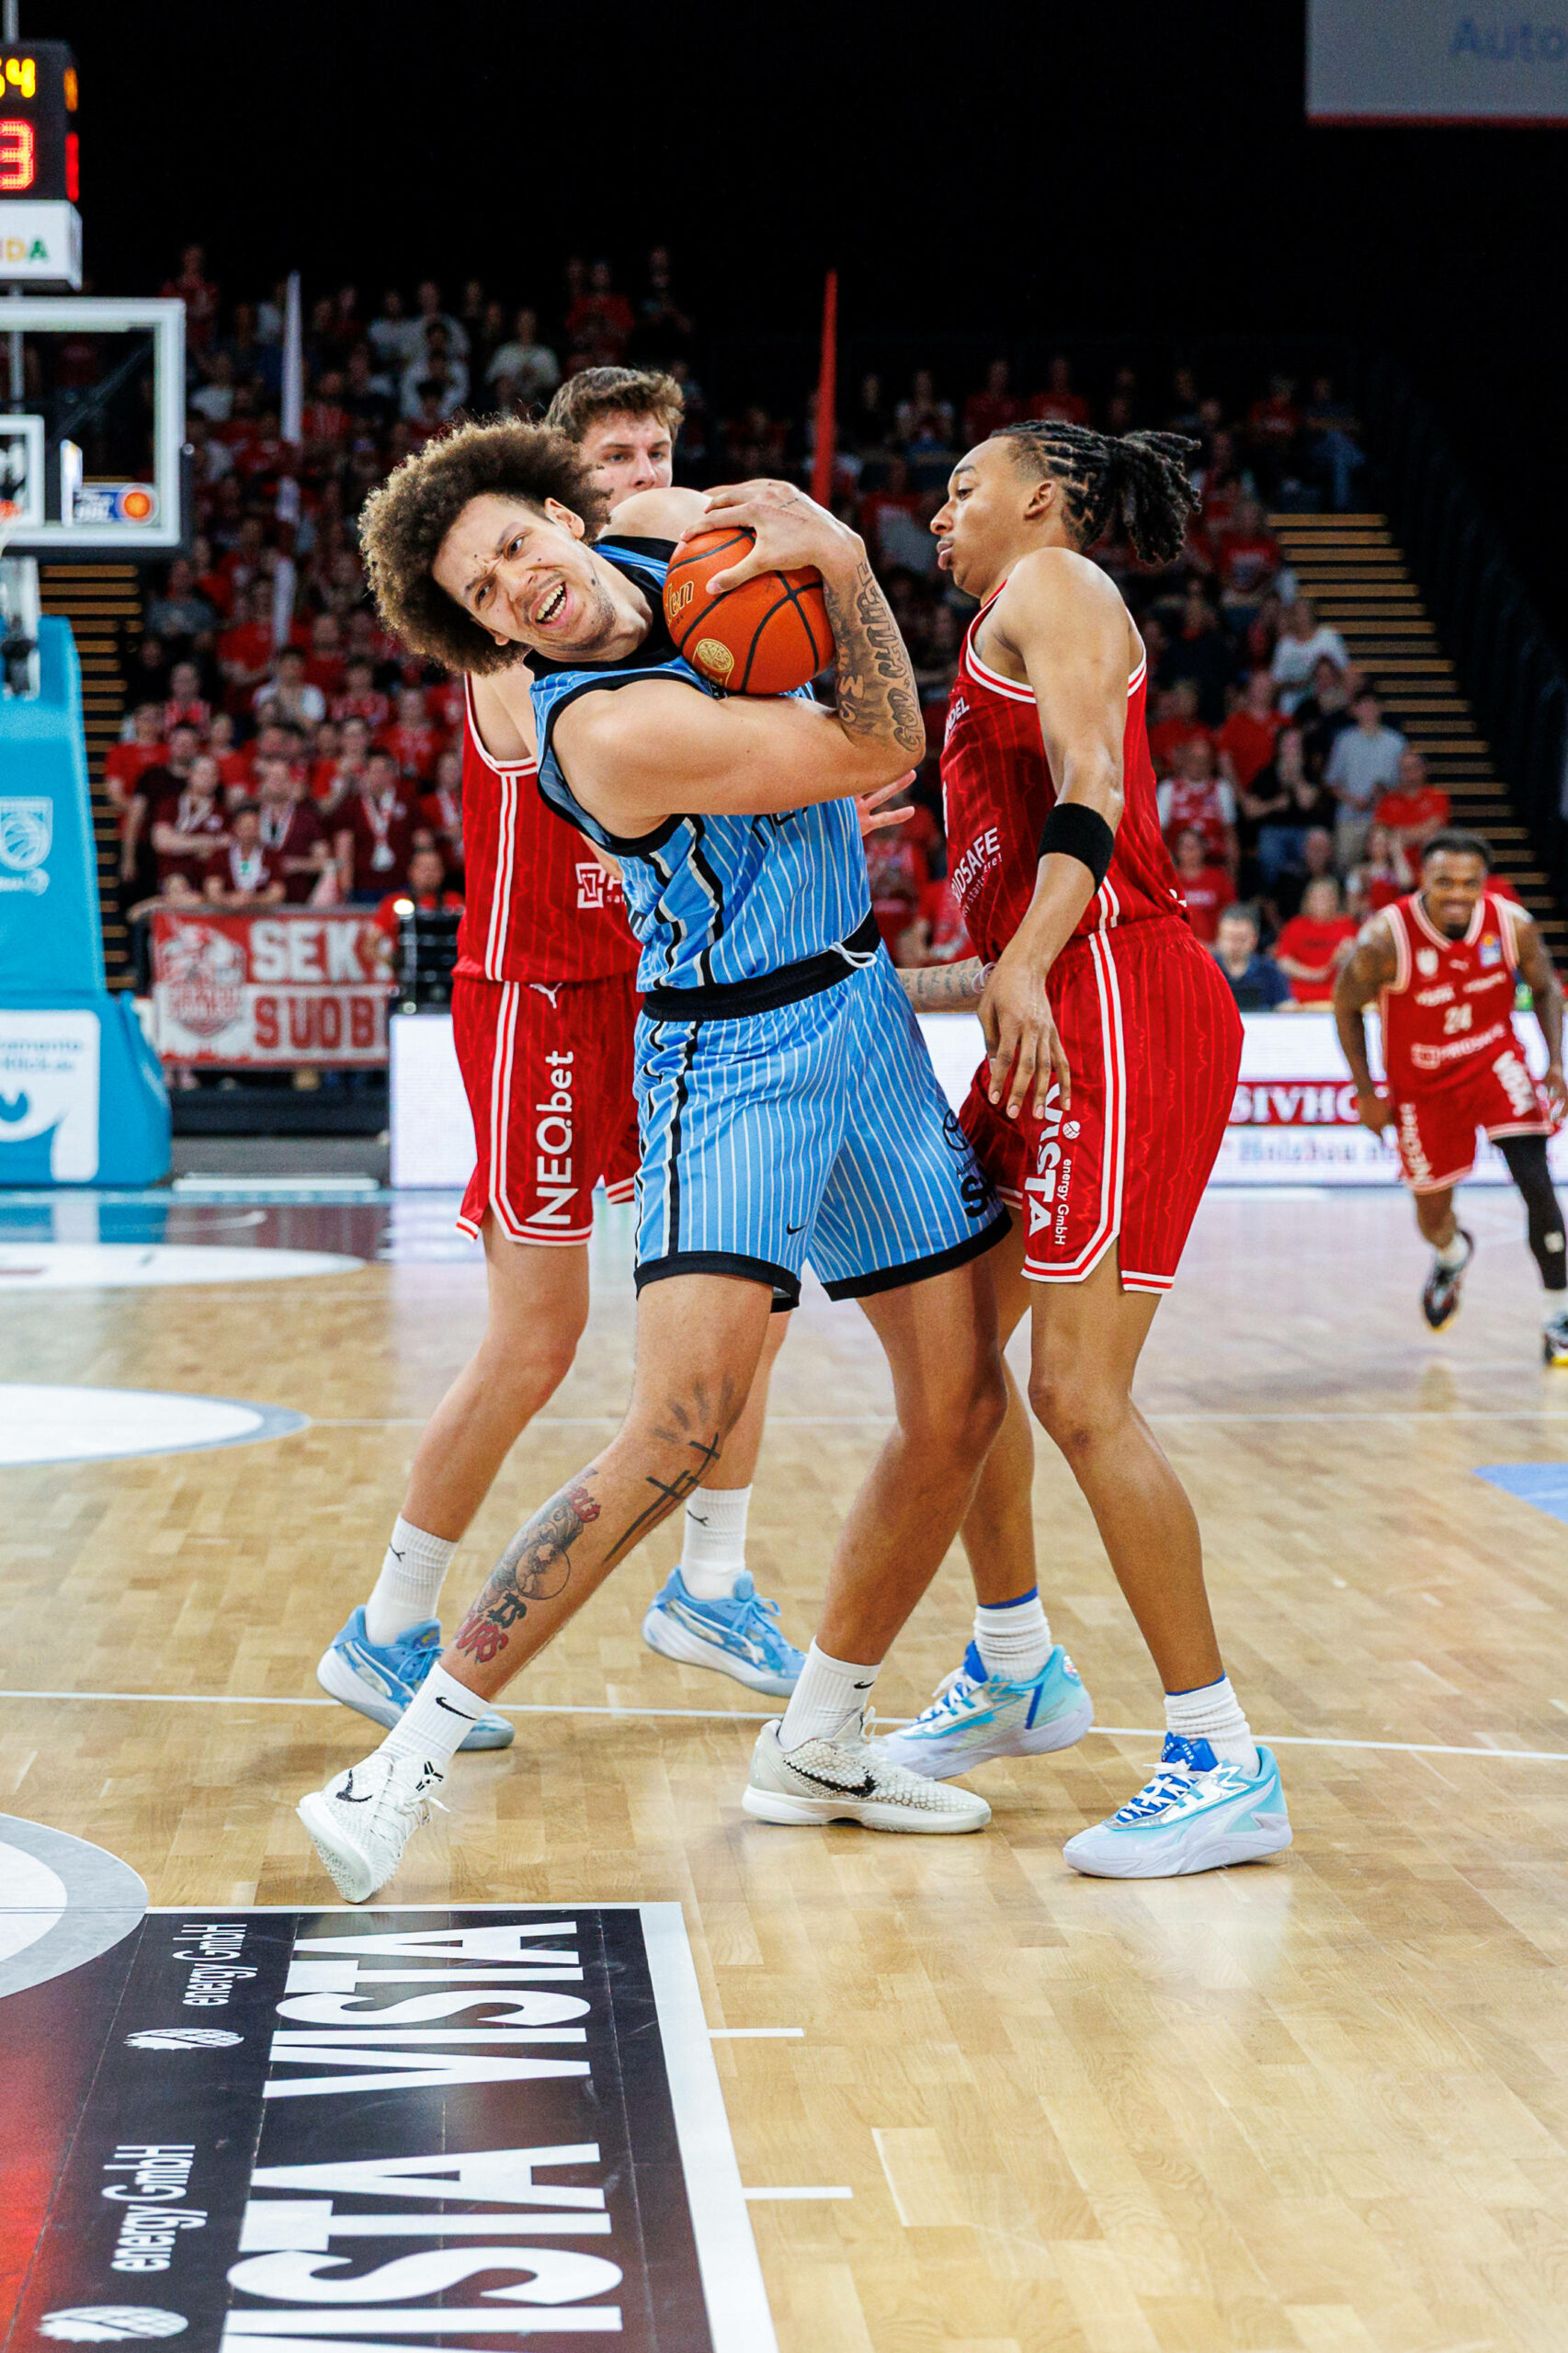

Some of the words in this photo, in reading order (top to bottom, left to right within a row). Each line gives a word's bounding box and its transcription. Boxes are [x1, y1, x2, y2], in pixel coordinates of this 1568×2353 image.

[0, 58, 36, 98] 4
[0, 238, 47, 262] DA
[1056, 1158, 1073, 1201] energy
[1053, 1203, 1070, 1245] GmbH
[172, 1923, 248, 1962] GmbH
[183, 1963, 258, 2007] energy
[262, 1920, 592, 2099] VISTA
[101, 2143, 197, 2202] GmbH
[110, 2204, 209, 2273] energy
[220, 2142, 624, 2353] ISTA
